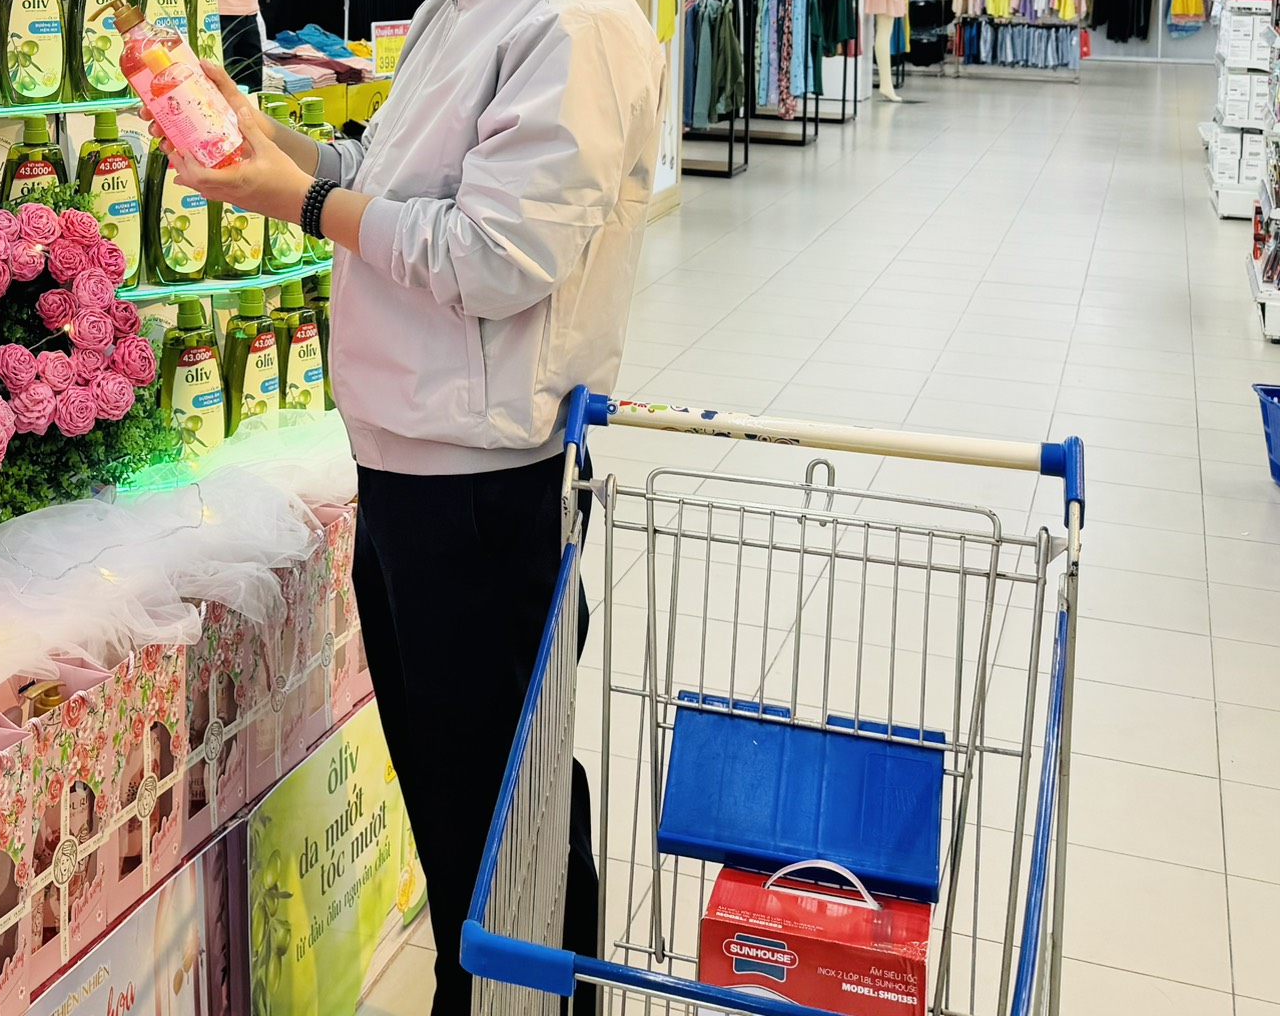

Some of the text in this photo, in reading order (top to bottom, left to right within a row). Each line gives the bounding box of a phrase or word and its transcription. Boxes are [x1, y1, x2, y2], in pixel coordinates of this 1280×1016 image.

[299, 783, 365, 880] da mướt
[321, 800, 388, 897] tóc mượt
[296, 940, 307, 963] từ
[308, 912, 324, 949] dầu
[344, 865, 373, 909] nguyên
[375, 837, 391, 874] chất
[729, 943, 793, 964] SUNHOUSE
[81, 961, 111, 997] NHIÊN
[817, 965, 837, 978] INOX
[843, 969, 859, 982] LỚP
[875, 978, 918, 994] SUNHOUSE
[869, 965, 918, 984] ẤM SIÊU TỐC
[841, 982, 918, 1005] MODEL: SHD1353
